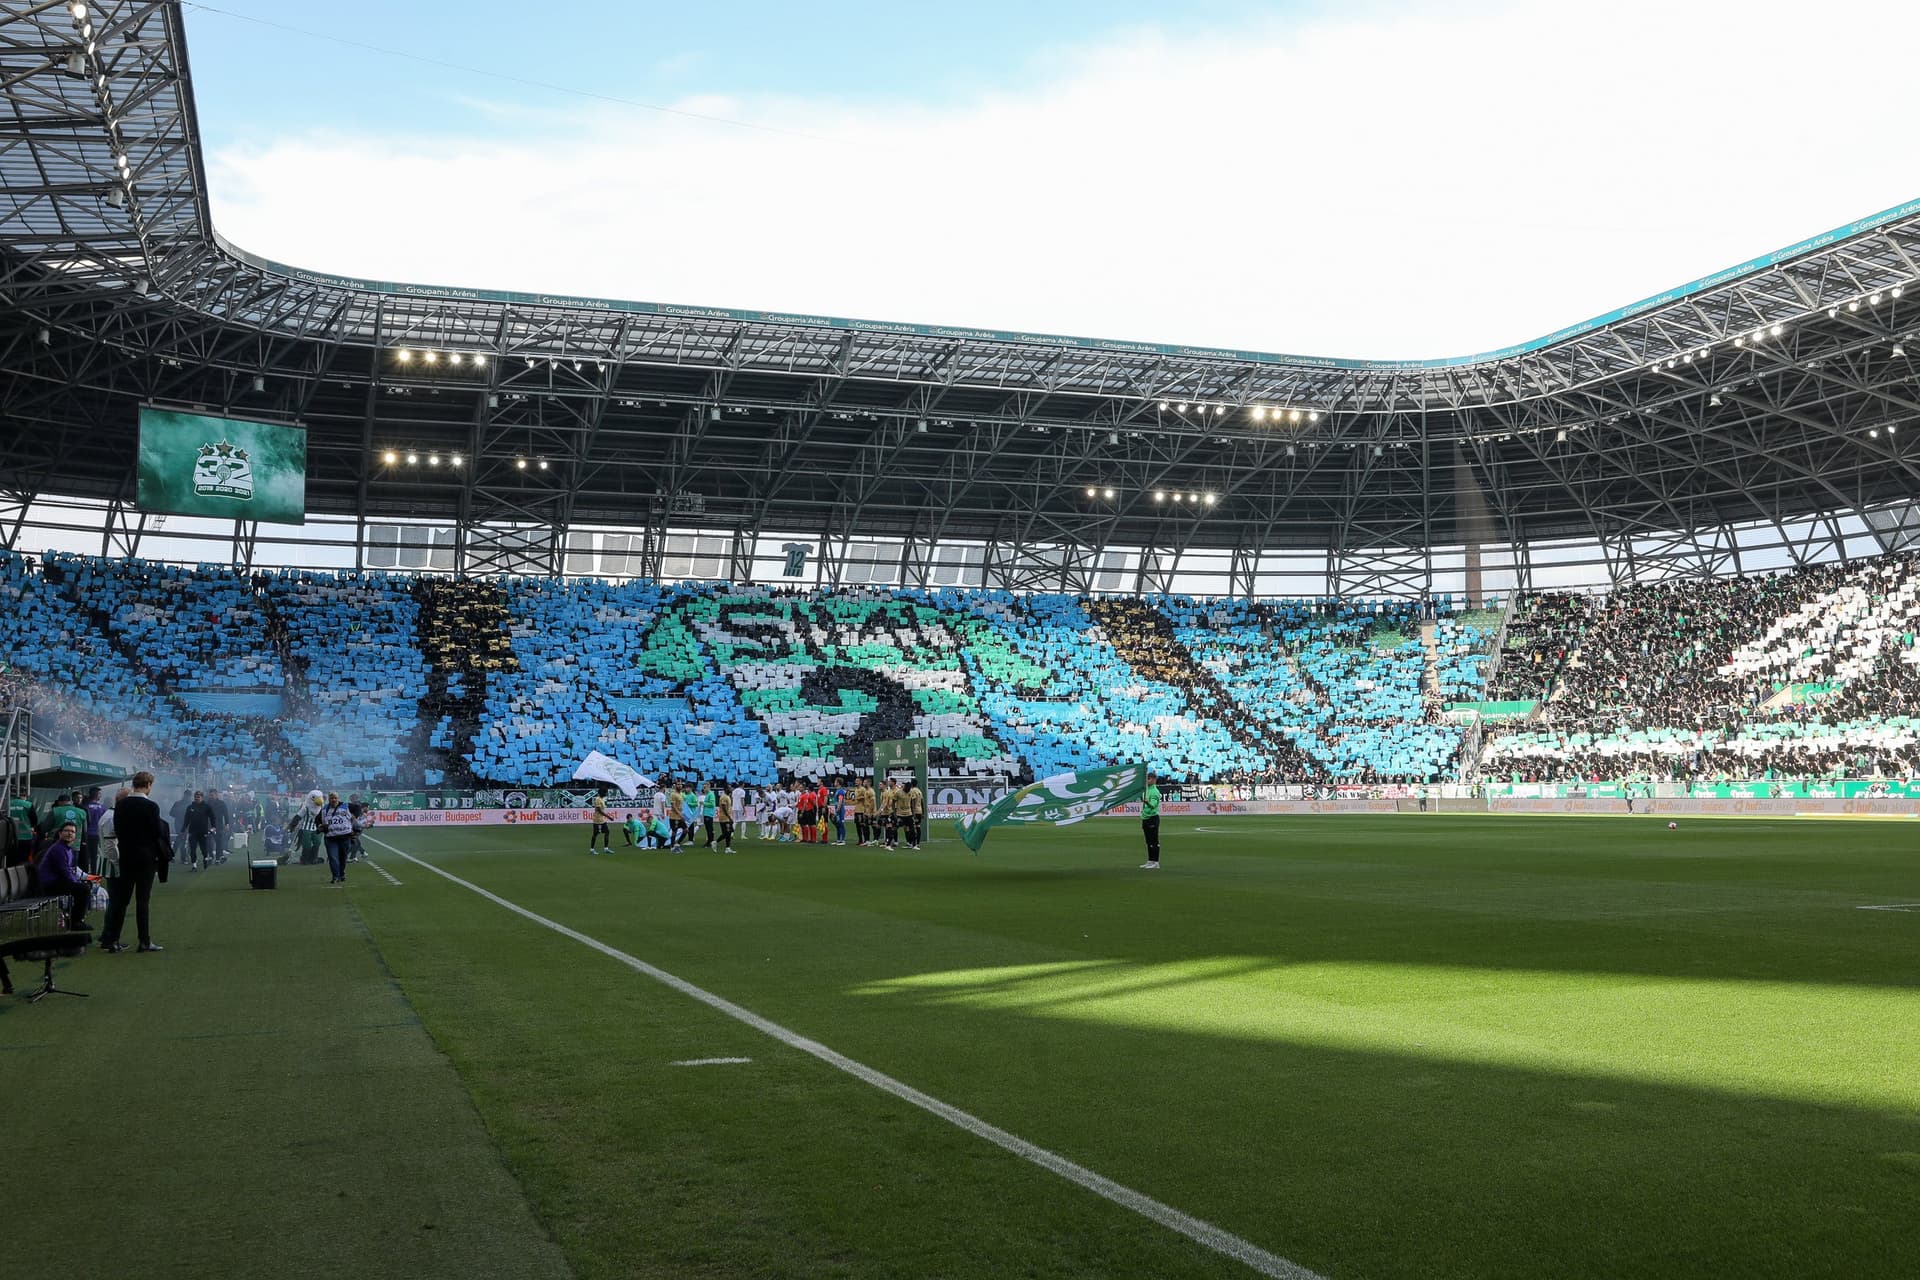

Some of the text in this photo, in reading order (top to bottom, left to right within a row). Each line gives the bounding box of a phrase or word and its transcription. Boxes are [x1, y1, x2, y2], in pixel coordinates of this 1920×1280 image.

[296, 271, 338, 287] Groupama
[405, 286, 478, 298] Groupama Aréna
[542, 296, 584, 308] Groupama
[665, 306, 706, 318] Groupama
[768, 314, 806, 325] Groupama
[855, 321, 892, 332] Groupama
[937, 327, 972, 339] Groupama
[1021, 334, 1055, 346] Groupama
[1102, 341, 1137, 352] Groupama
[194, 455, 253, 491] 32
[789, 549, 804, 569] 12
[1111, 803, 1191, 813] hufbau Budapest
[1219, 803, 1247, 812] hufbau
[379, 811, 482, 825] hufbau akker Budapest
[520, 811, 555, 821] hufbau
[558, 811, 580, 820] akker
